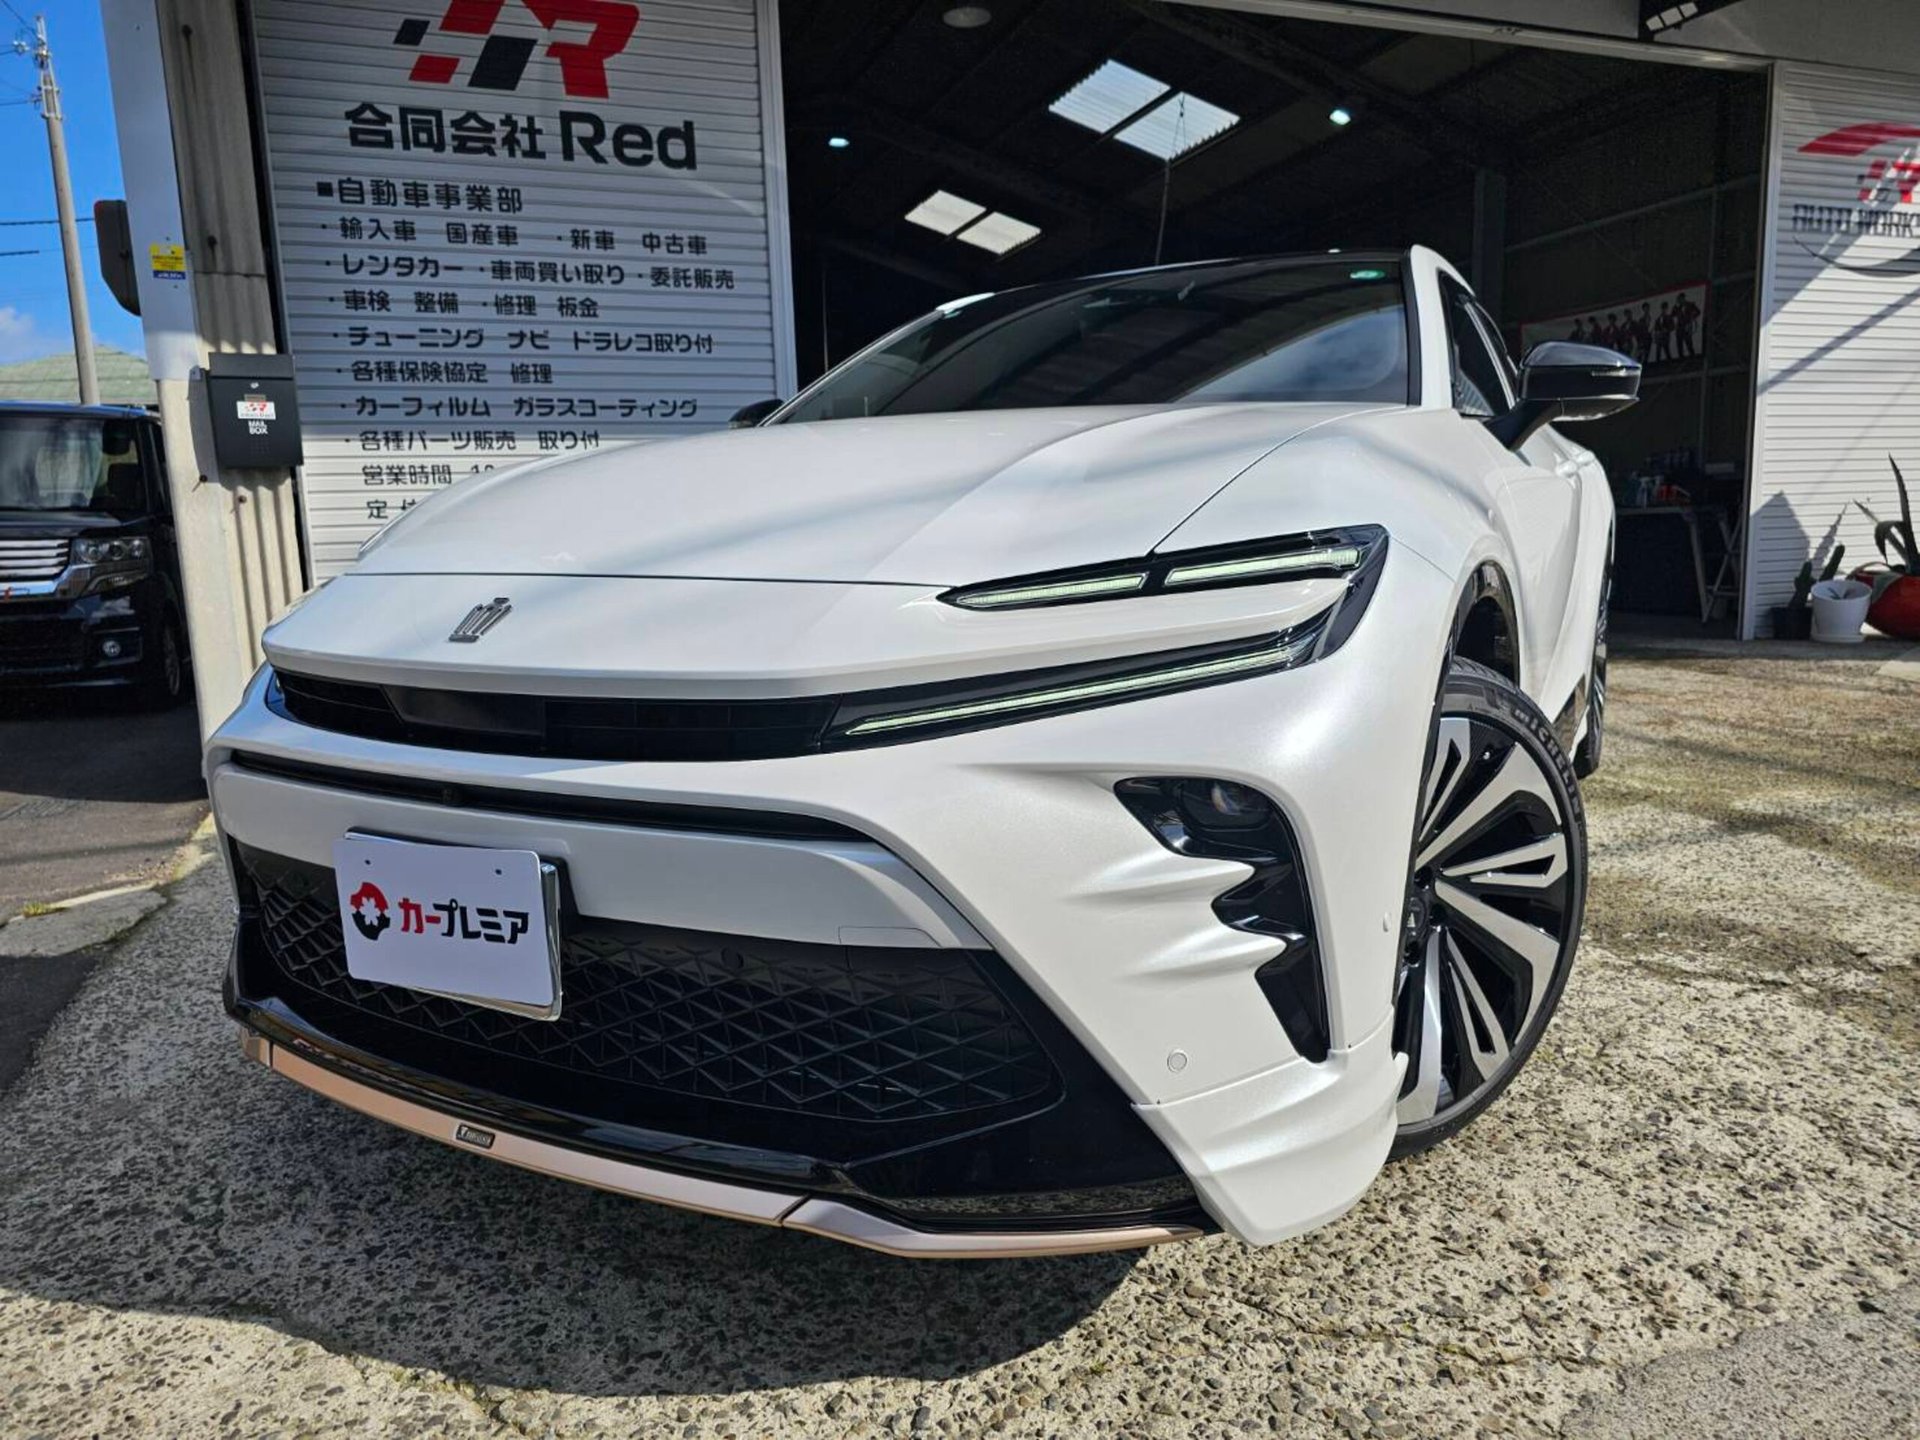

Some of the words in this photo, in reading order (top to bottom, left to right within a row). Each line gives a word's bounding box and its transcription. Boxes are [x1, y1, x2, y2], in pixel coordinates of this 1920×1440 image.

[345, 102, 546, 159] 合同会社
[559, 110, 697, 170] Red
[338, 177, 522, 214] 自動車事業部
[642, 232, 707, 255] 中古車
[343, 253, 463, 278] レンタカー
[557, 296, 599, 318] 板金
[348, 326, 484, 348] チューニング
[507, 330, 550, 350] ナビ
[510, 362, 553, 384] 修理
[355, 396, 491, 417] カーフィルム
[513, 396, 698, 418] ガラスコーティング
[362, 464, 452, 486] 営業時間
[398, 897, 529, 944] カープレミア
